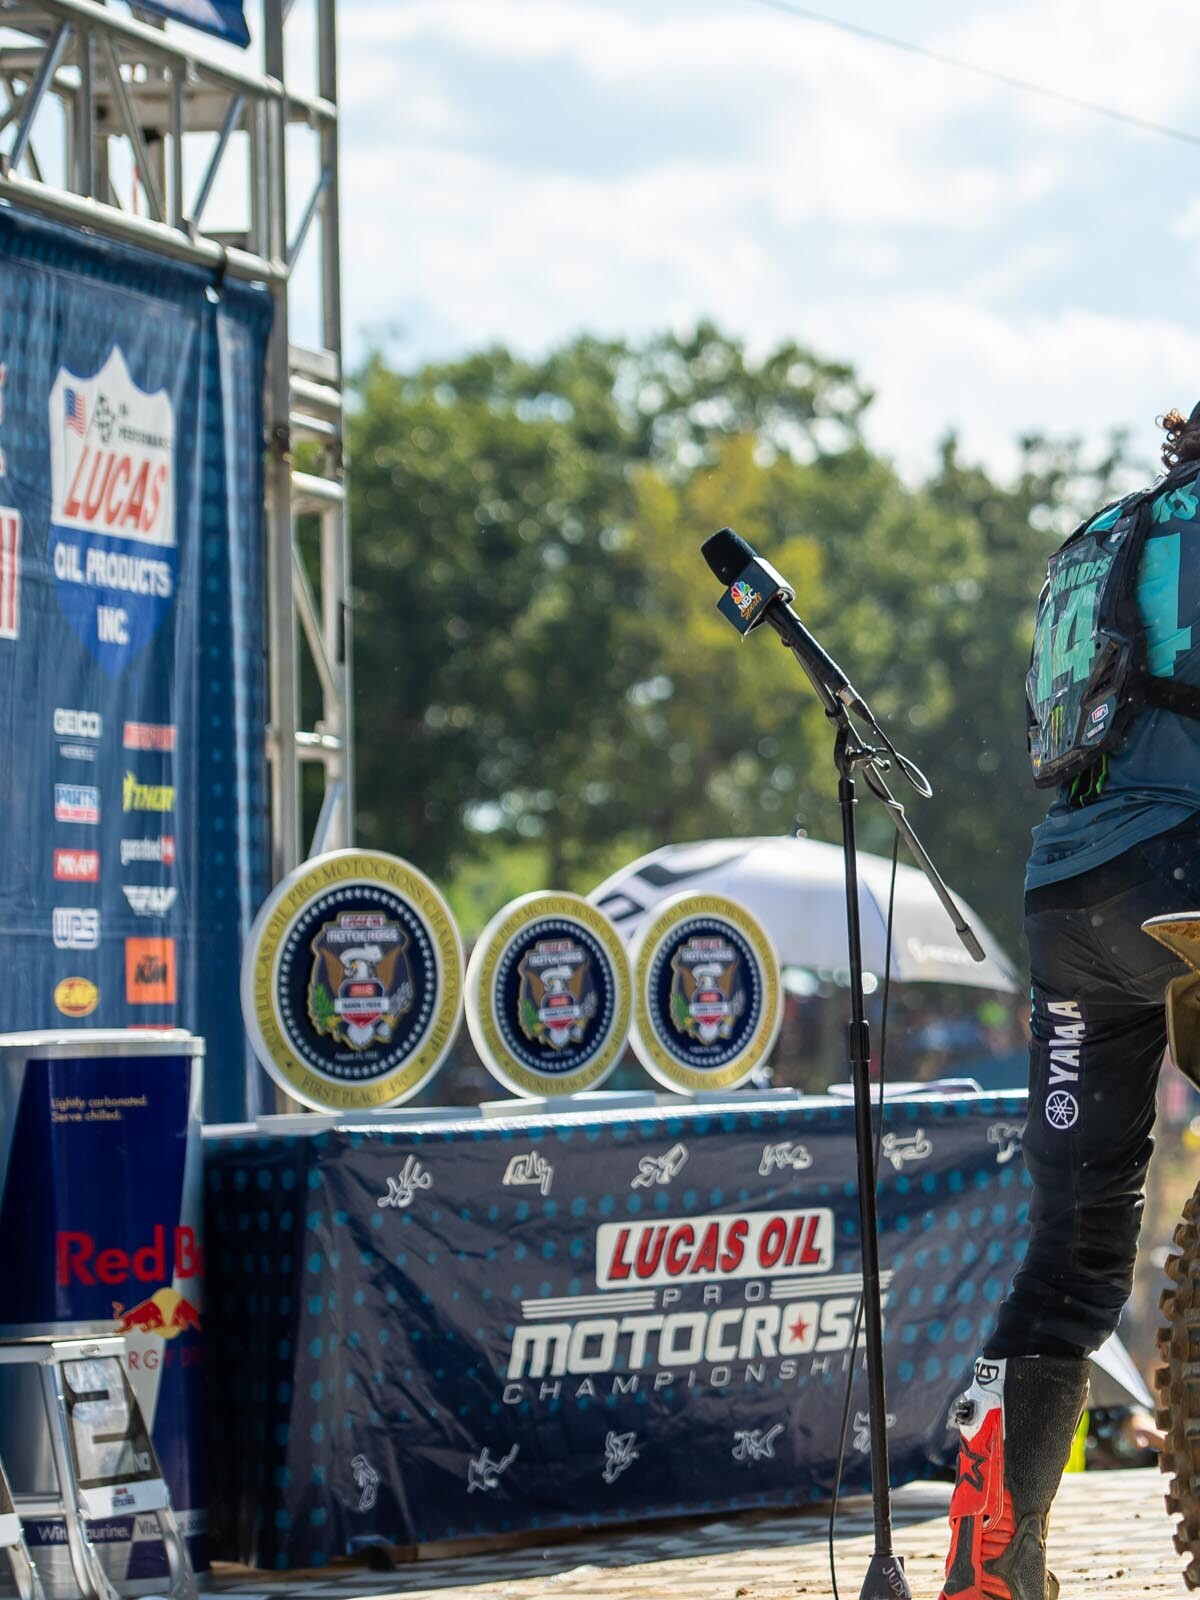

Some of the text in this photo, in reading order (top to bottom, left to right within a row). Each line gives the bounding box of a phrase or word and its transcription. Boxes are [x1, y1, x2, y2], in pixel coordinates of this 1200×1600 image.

[64, 447, 168, 532] LUCAS
[54, 543, 173, 598] OIL PRODUCTS
[737, 588, 757, 611] NBC
[1037, 582, 1098, 704] 14
[264, 909, 286, 943] OIL
[283, 872, 318, 909] PRO
[317, 859, 425, 901] MOTOCROSS
[327, 928, 398, 943] MOTOCROSS
[135, 956, 167, 986] KTM
[52, 1111, 82, 1123] Serve
[56, 1224, 165, 1286] Red
[608, 1216, 822, 1280] LUCAS OIL
[662, 1281, 765, 1307] PRO
[502, 1354, 868, 1405] CHAMPIONSHI
